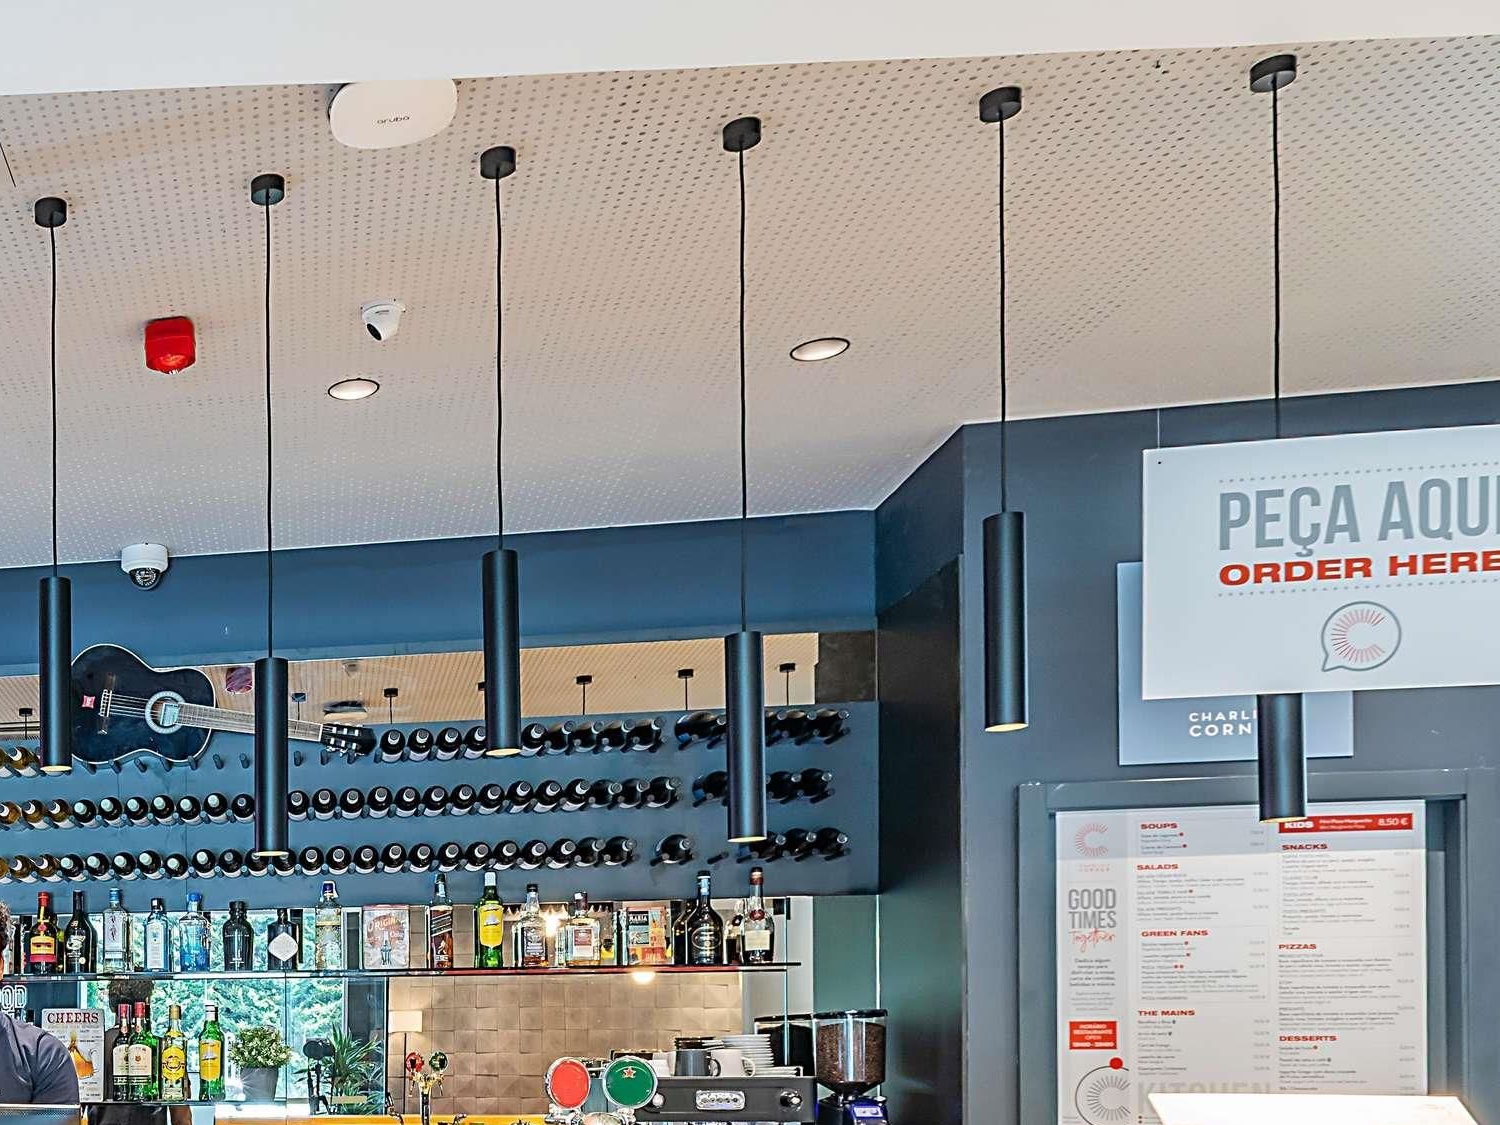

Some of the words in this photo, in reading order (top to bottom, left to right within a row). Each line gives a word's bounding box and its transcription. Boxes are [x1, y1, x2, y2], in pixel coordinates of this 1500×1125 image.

[1219, 485, 1360, 556] PEÇA
[1218, 557, 1373, 587] ORDER
[1388, 550, 1500, 577] HERE
[1188, 723, 1253, 737] CORN
[1140, 822, 1178, 830] SOUPS
[1284, 821, 1314, 829] KIDS
[1282, 843, 1328, 851] SNACKS
[1136, 863, 1179, 871] SALADS
[1068, 888, 1117, 910] GOOD
[1068, 910, 1117, 929] TIMES
[1180, 929, 1208, 937] FANS
[47, 1012, 99, 1023] CHEERS
